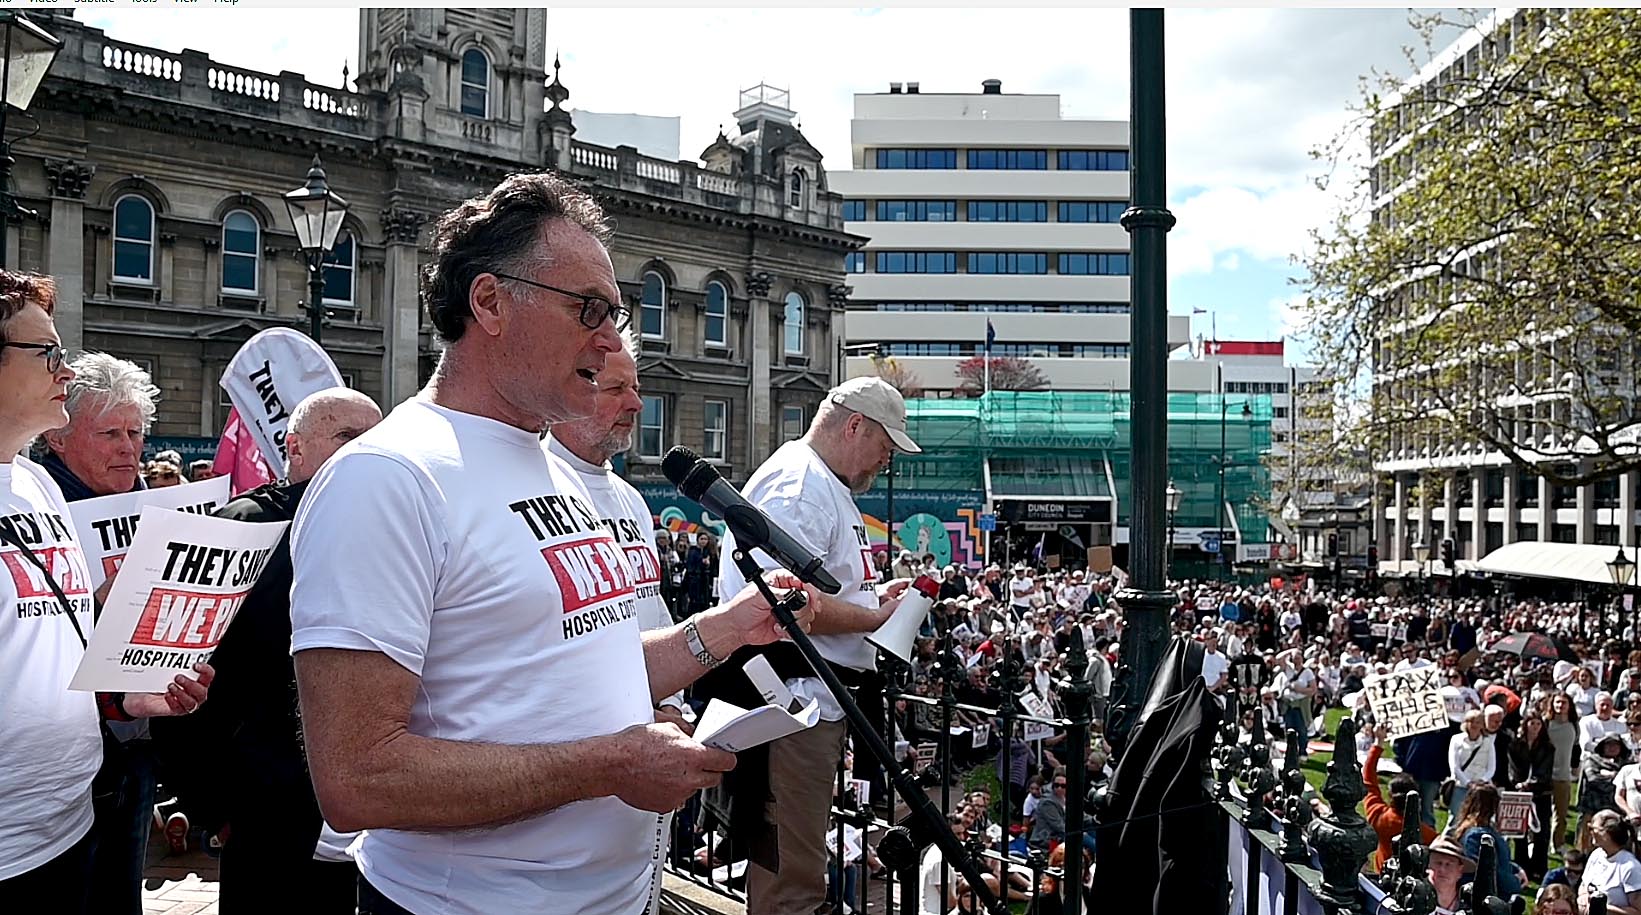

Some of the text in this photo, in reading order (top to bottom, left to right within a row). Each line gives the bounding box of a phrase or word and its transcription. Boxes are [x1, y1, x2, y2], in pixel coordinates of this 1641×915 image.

[248, 360, 289, 424] THEY
[508, 494, 581, 541] THEY
[161, 541, 238, 587] THEY
[562, 604, 621, 640] HOSPITAL
[120, 648, 191, 670] HOSPITAL
